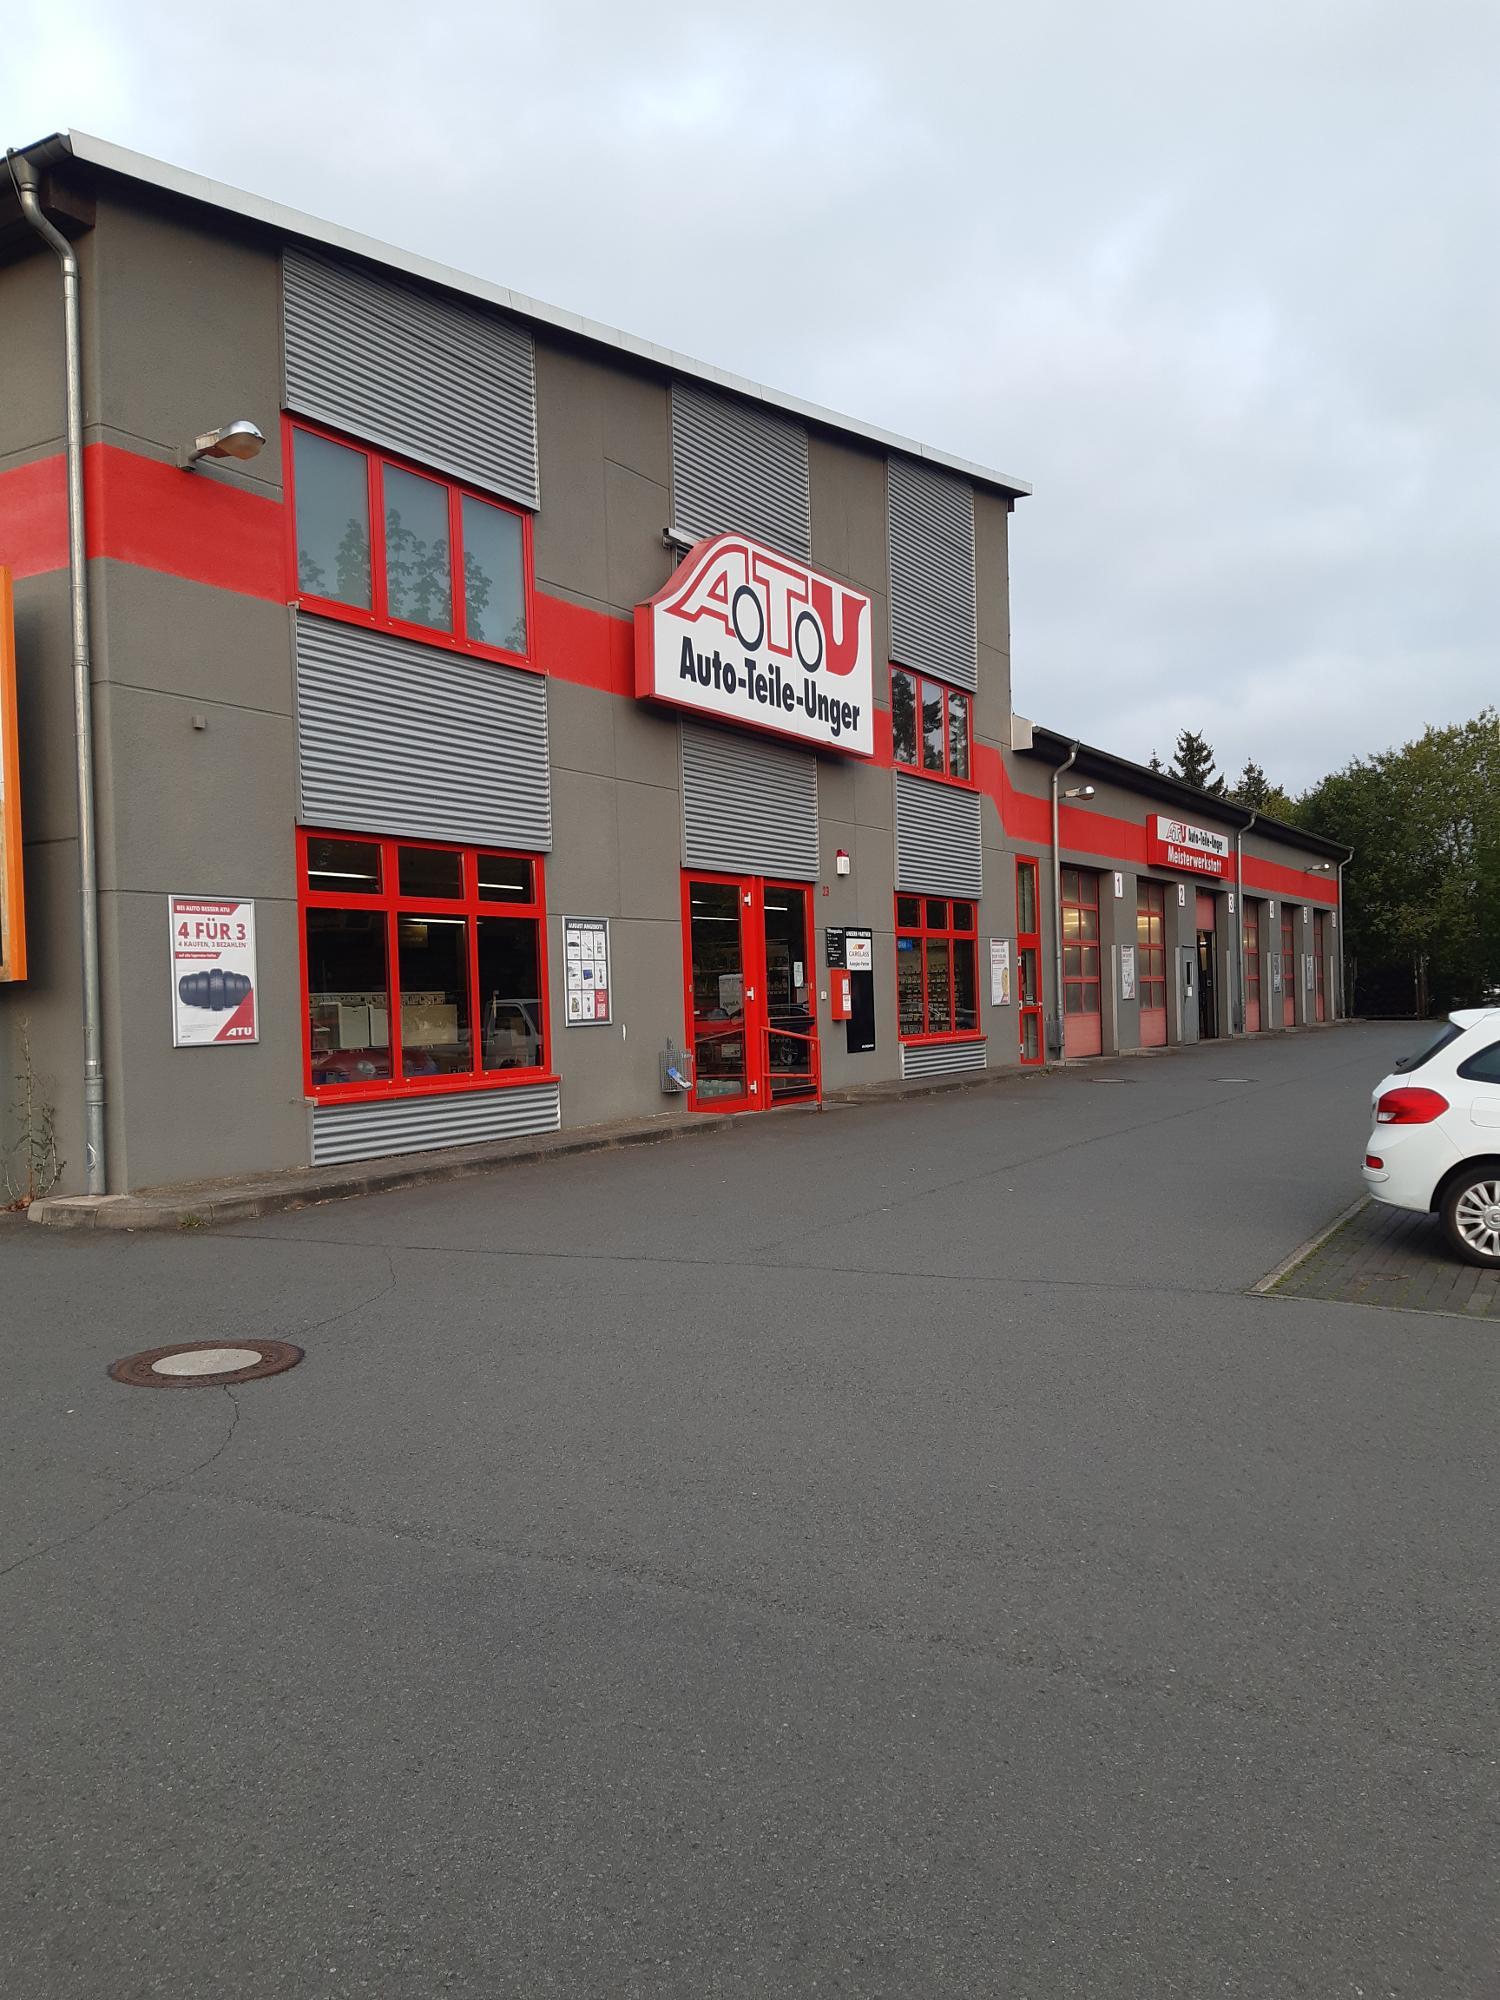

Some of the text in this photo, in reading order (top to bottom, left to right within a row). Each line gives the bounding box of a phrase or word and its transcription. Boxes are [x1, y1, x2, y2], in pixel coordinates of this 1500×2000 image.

[679, 635, 861, 737] Auto-Teile-Unger
[1166, 822, 1187, 844] ATU
[1188, 827, 1223, 853] Auto-Teile-Unger
[1167, 844, 1222, 873] Meisterwerkstatt
[1179, 887, 1184, 903] 2
[178, 917, 246, 941] 4 FÜR 3
[226, 1026, 252, 1036] ATU
